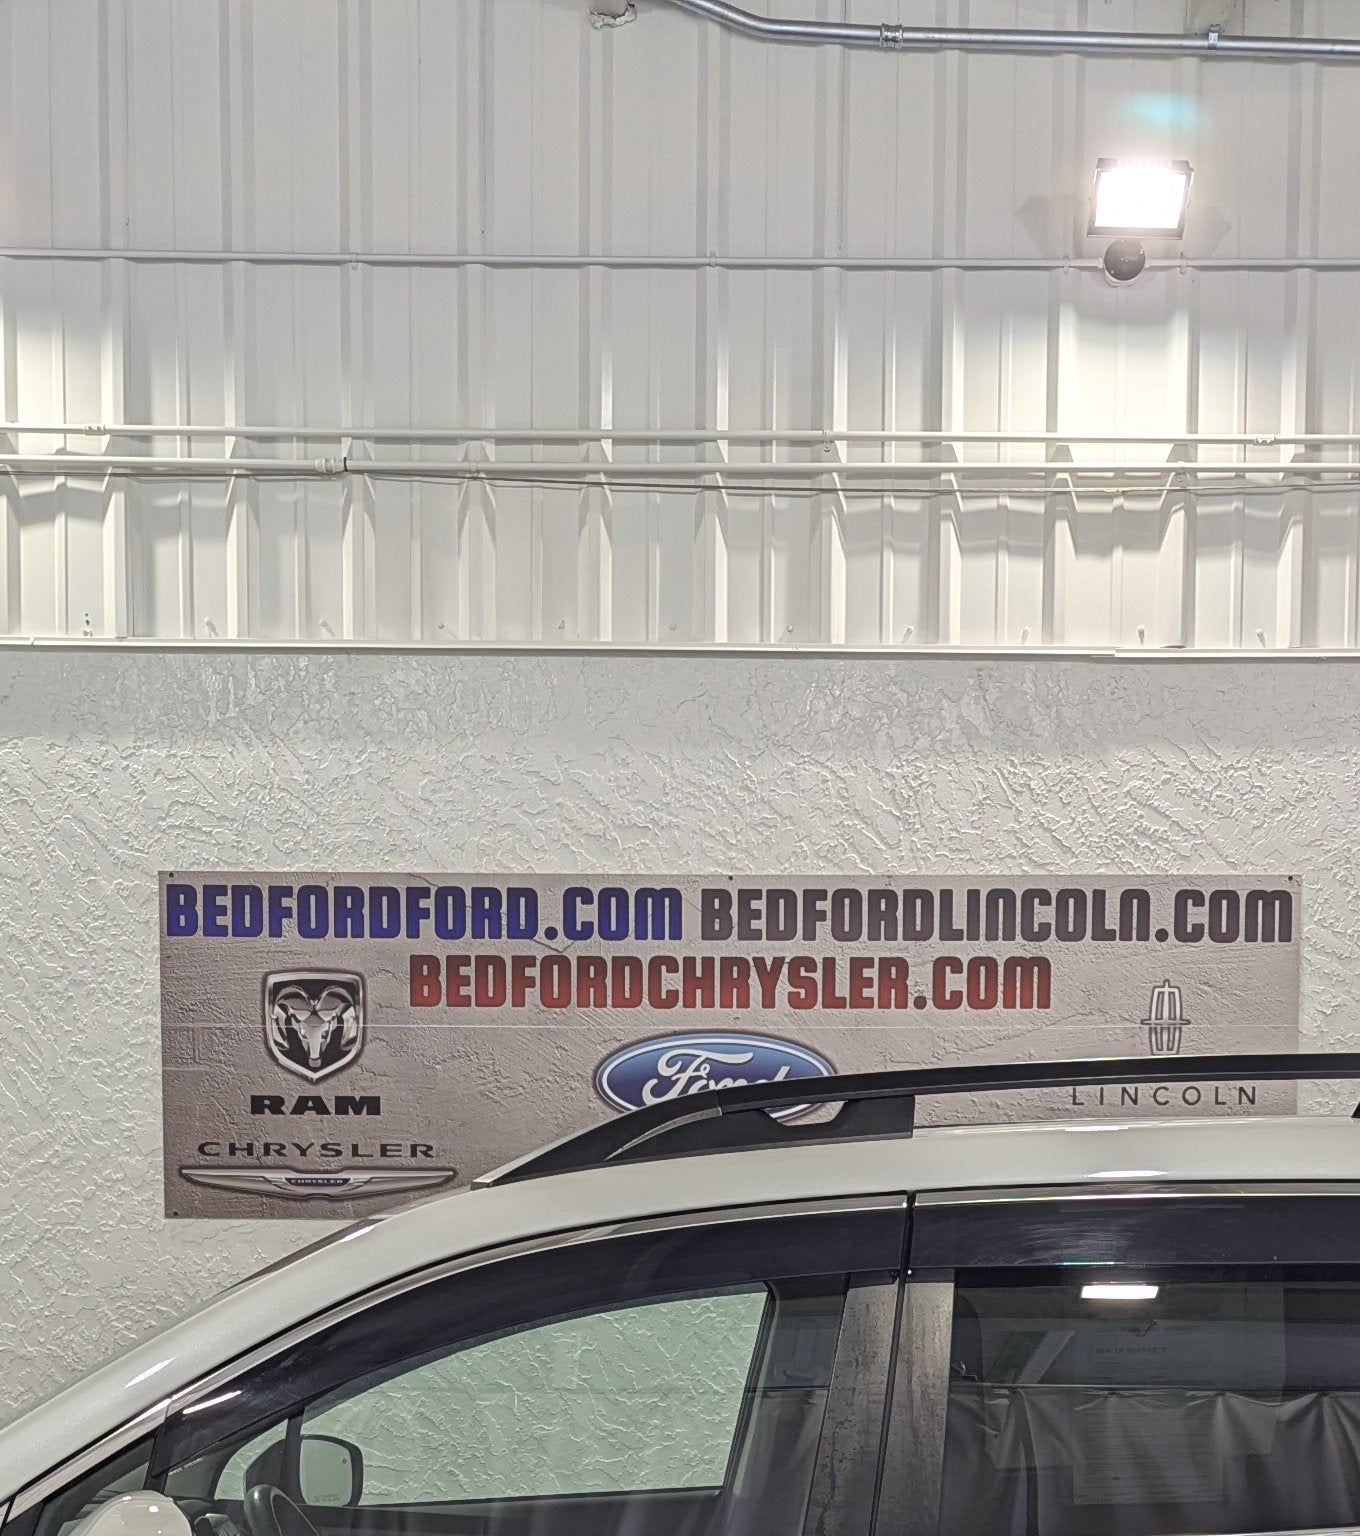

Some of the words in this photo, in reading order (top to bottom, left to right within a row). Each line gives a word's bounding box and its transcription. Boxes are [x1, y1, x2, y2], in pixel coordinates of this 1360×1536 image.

[166, 884, 683, 941] BEDFORDFORD.COM
[700, 888, 1293, 943] BEDFORDLINCOLN.COM
[409, 955, 1052, 1010] BEDFORDCHRYSLER.COM
[642, 1048, 791, 1106] Fo
[1072, 1085, 1257, 1106] LINCOLN
[250, 1094, 382, 1116] RAM
[197, 1141, 436, 1159] CHRYSLER
